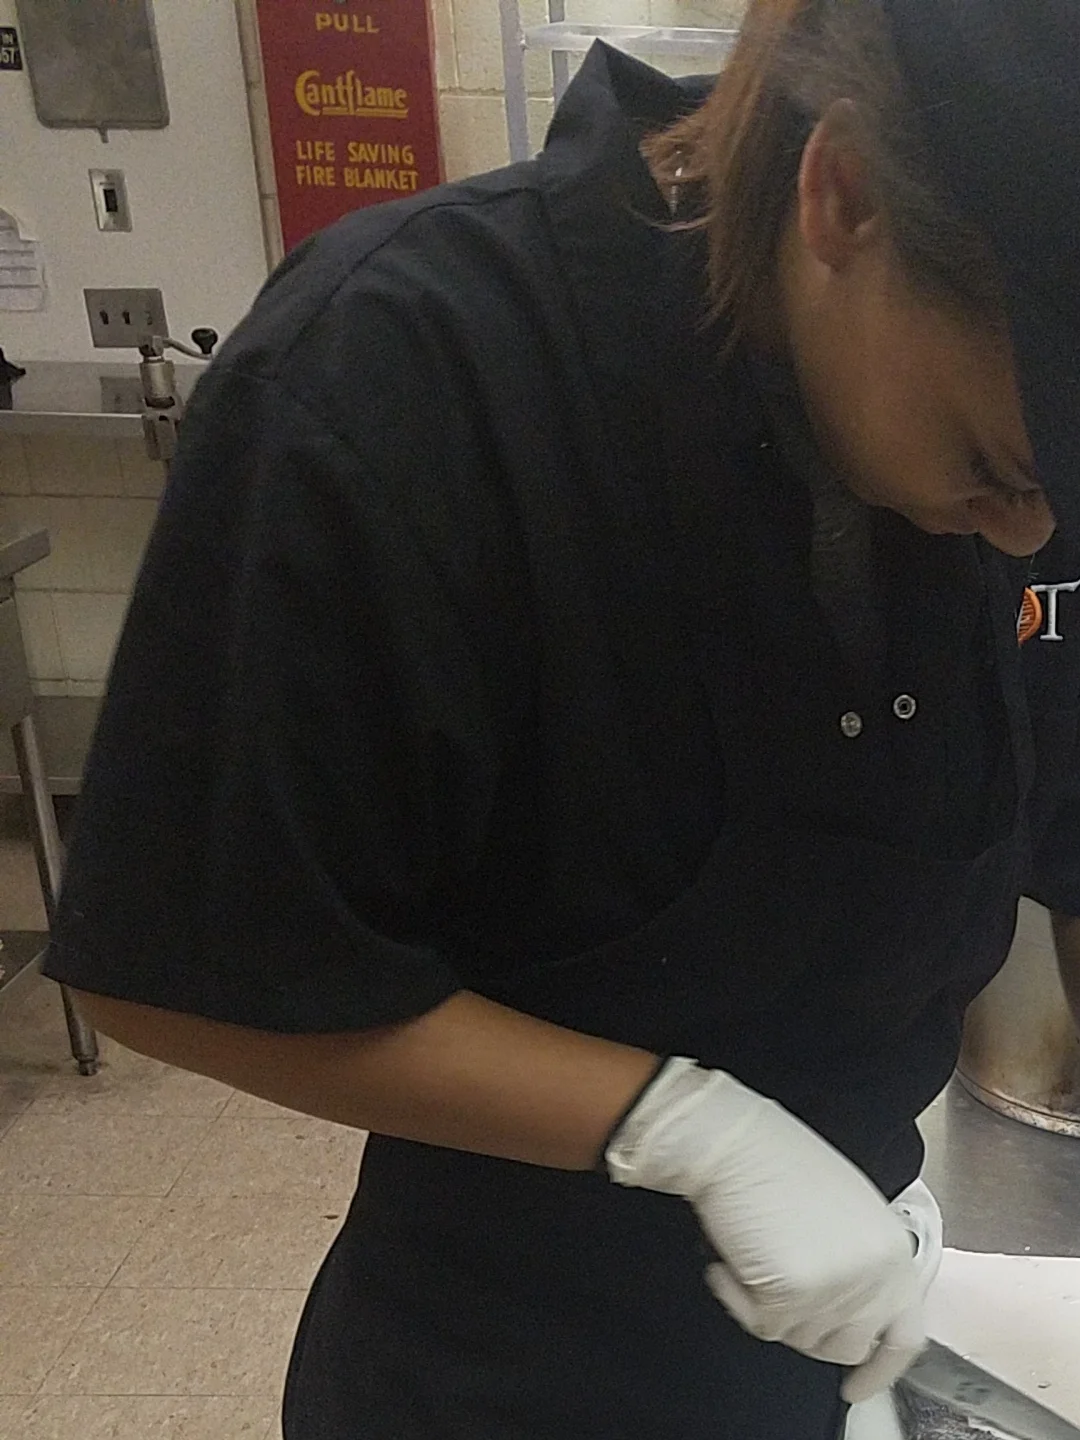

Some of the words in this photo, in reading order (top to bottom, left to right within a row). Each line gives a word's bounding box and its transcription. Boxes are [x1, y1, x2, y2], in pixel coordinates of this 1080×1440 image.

[315, 12, 380, 34] PULL
[296, 139, 336, 161] LIFE
[347, 141, 415, 165] SAVING
[296, 165, 336, 187] FIRE
[344, 167, 419, 191] BLANKET
